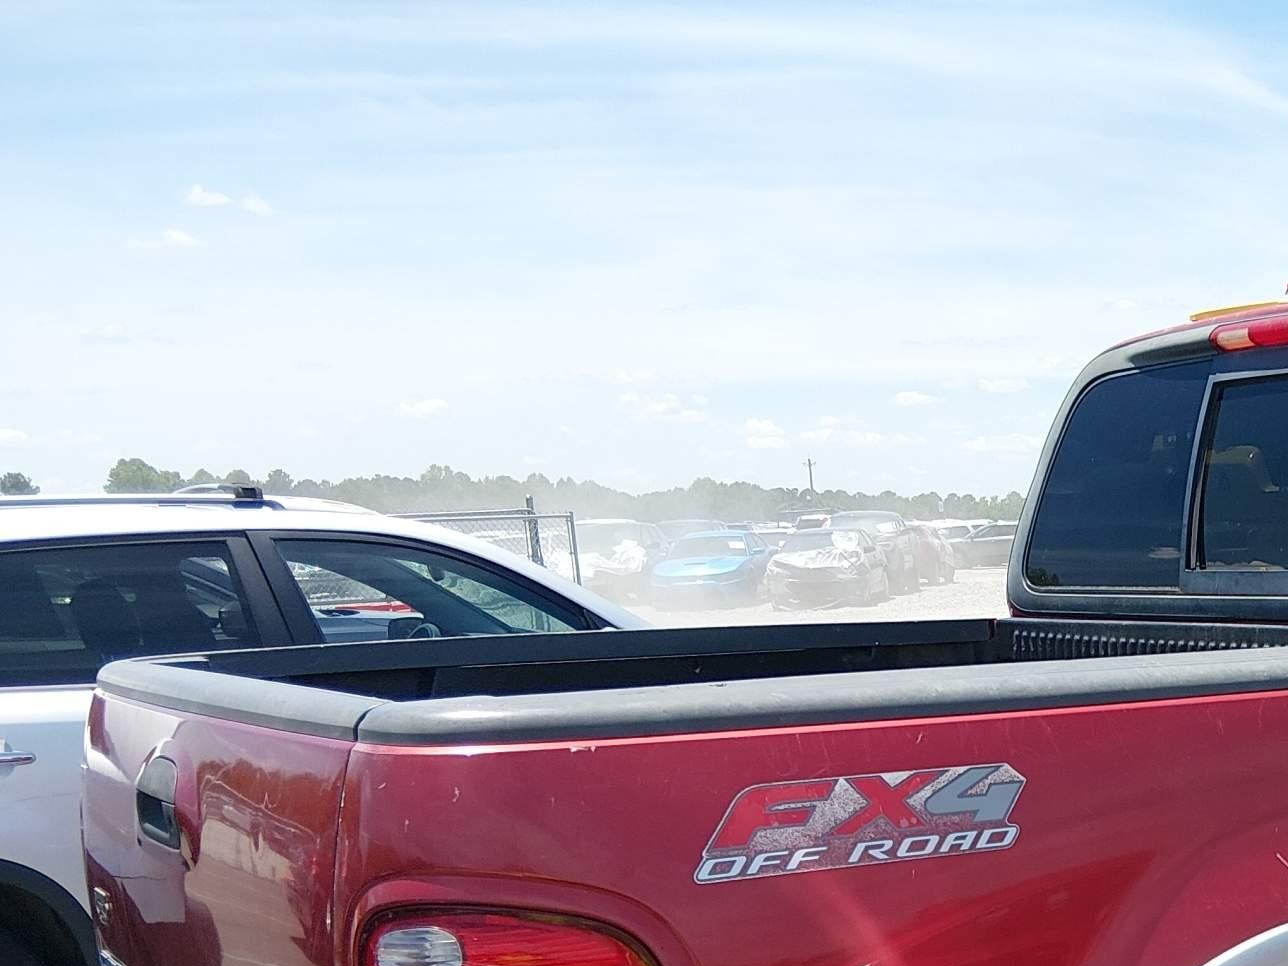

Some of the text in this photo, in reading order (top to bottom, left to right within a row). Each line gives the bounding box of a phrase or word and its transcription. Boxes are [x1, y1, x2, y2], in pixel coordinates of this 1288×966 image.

[707, 764, 1026, 850] FX4
[697, 826, 1019, 882] OFF ROAD
